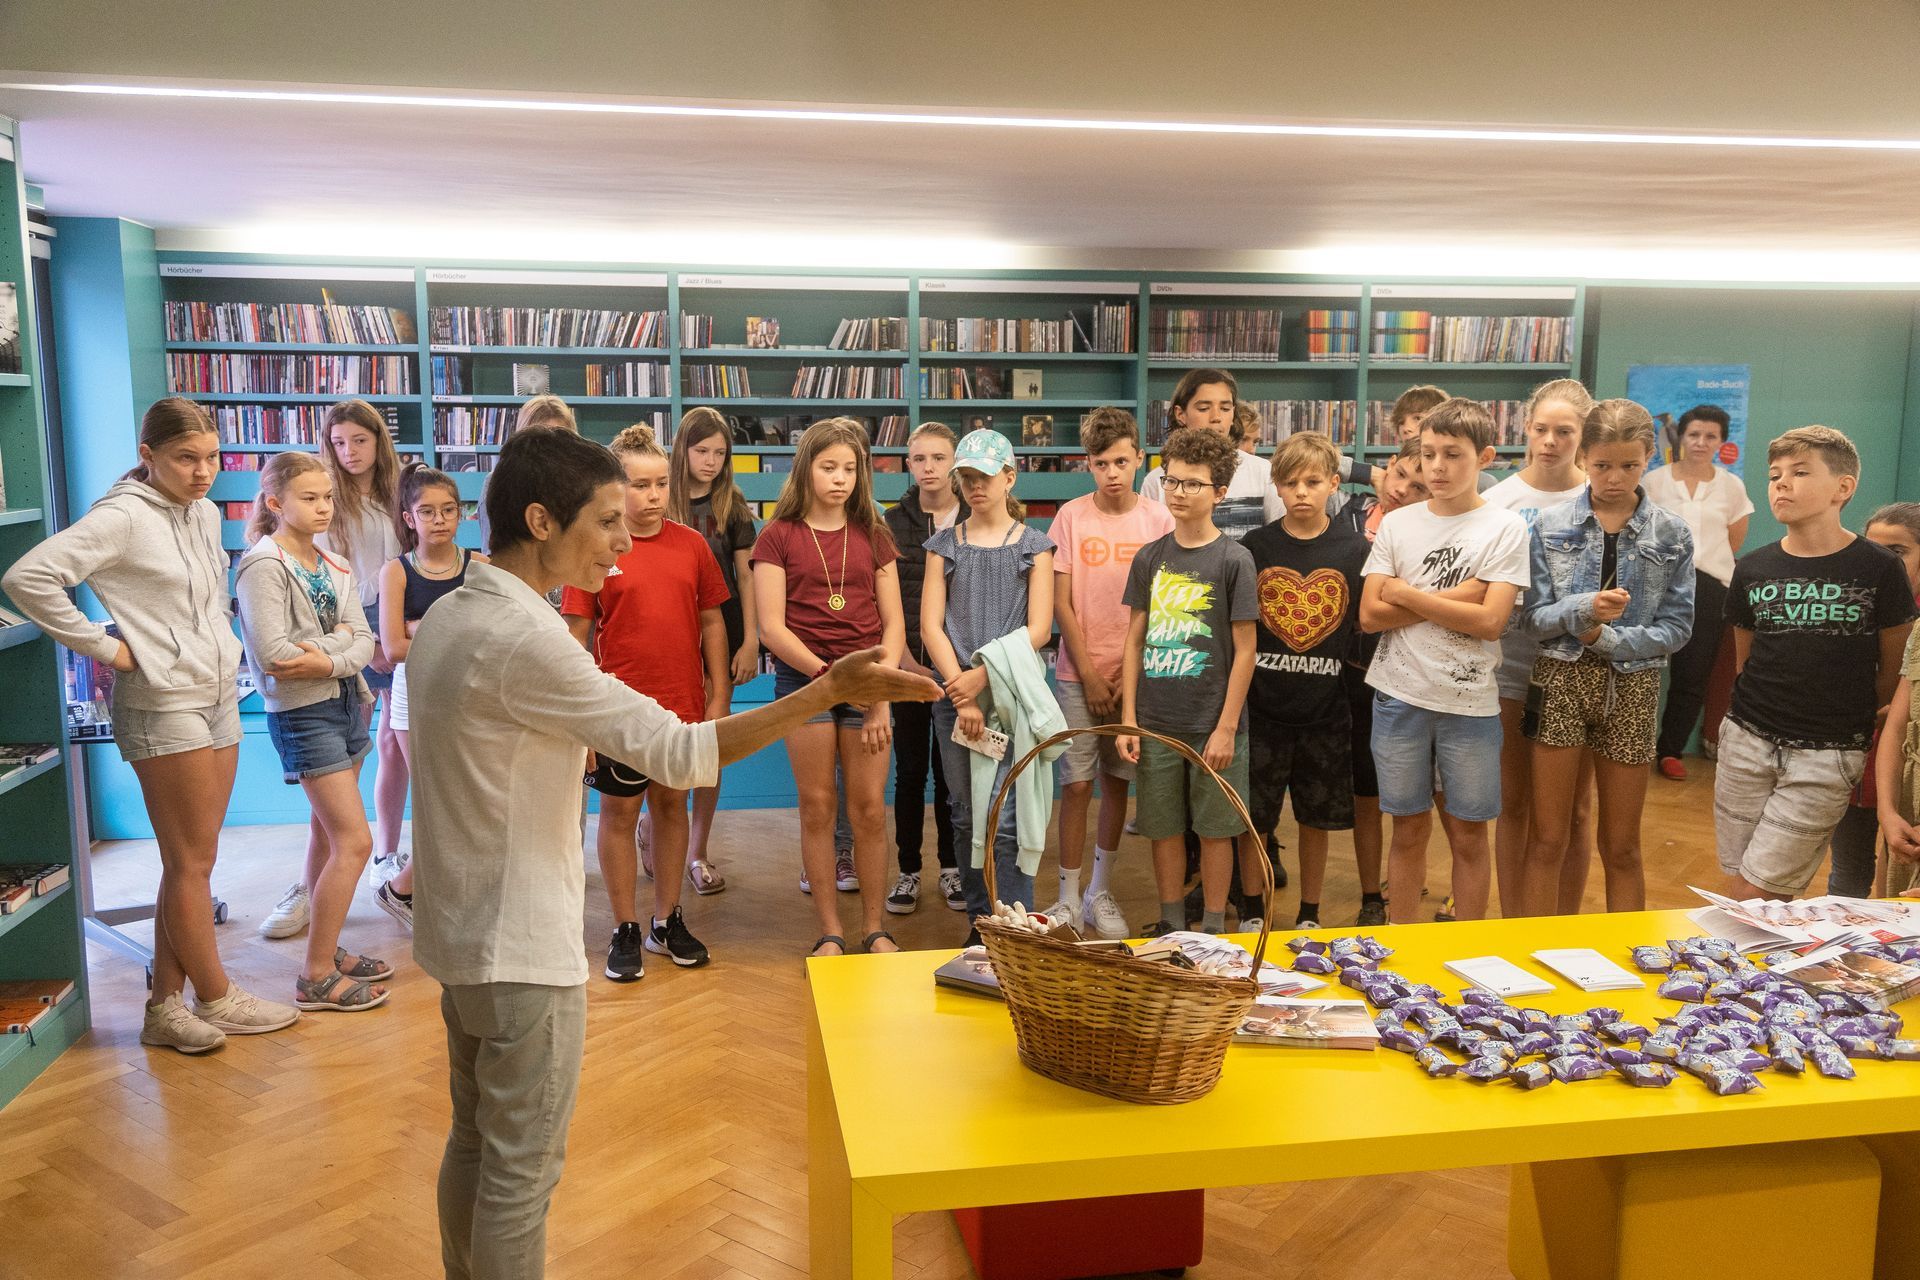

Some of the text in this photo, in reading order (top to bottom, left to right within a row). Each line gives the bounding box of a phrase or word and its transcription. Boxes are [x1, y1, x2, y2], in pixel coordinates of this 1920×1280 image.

[167, 266, 203, 274] Hörbücher
[432, 272, 467, 280] Hörbücher
[1696, 380, 1744, 389] Bade-Buch
[1422, 546, 1463, 576] STAY
[1152, 569, 1204, 617] KEEP
[1748, 583, 1841, 606] NO BAD
[1784, 603, 1861, 622] VIBES
[1144, 646, 1199, 676] SKATE
[1256, 652, 1342, 676] IZZATARIAN
